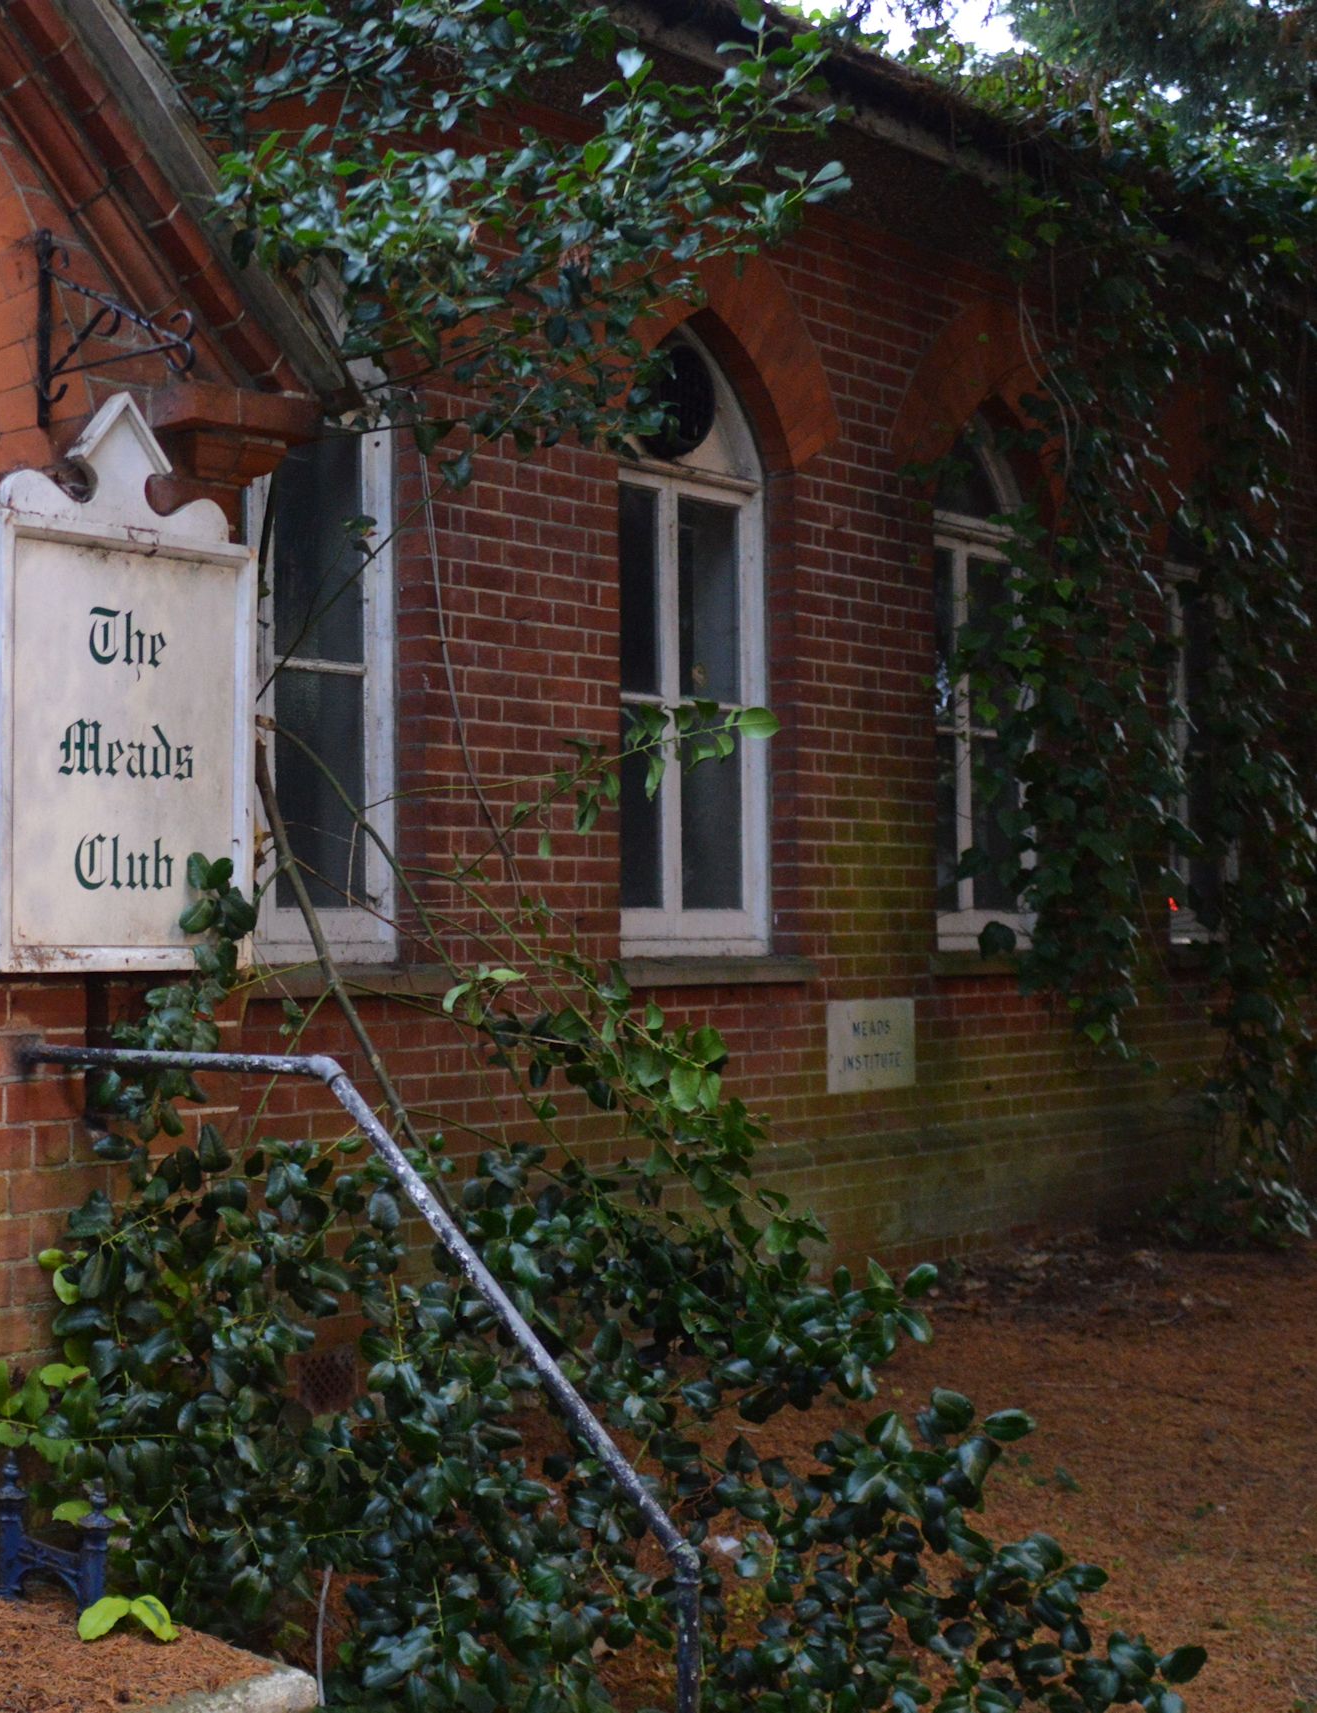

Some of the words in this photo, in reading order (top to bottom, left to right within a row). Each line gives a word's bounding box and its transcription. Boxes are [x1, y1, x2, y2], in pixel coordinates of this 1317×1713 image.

[89, 606, 167, 681] The
[58, 718, 194, 780] Meads
[74, 833, 173, 891] Club
[852, 1019, 891, 1037] MEADS
[842, 1051, 902, 1072] INSTITUTE
